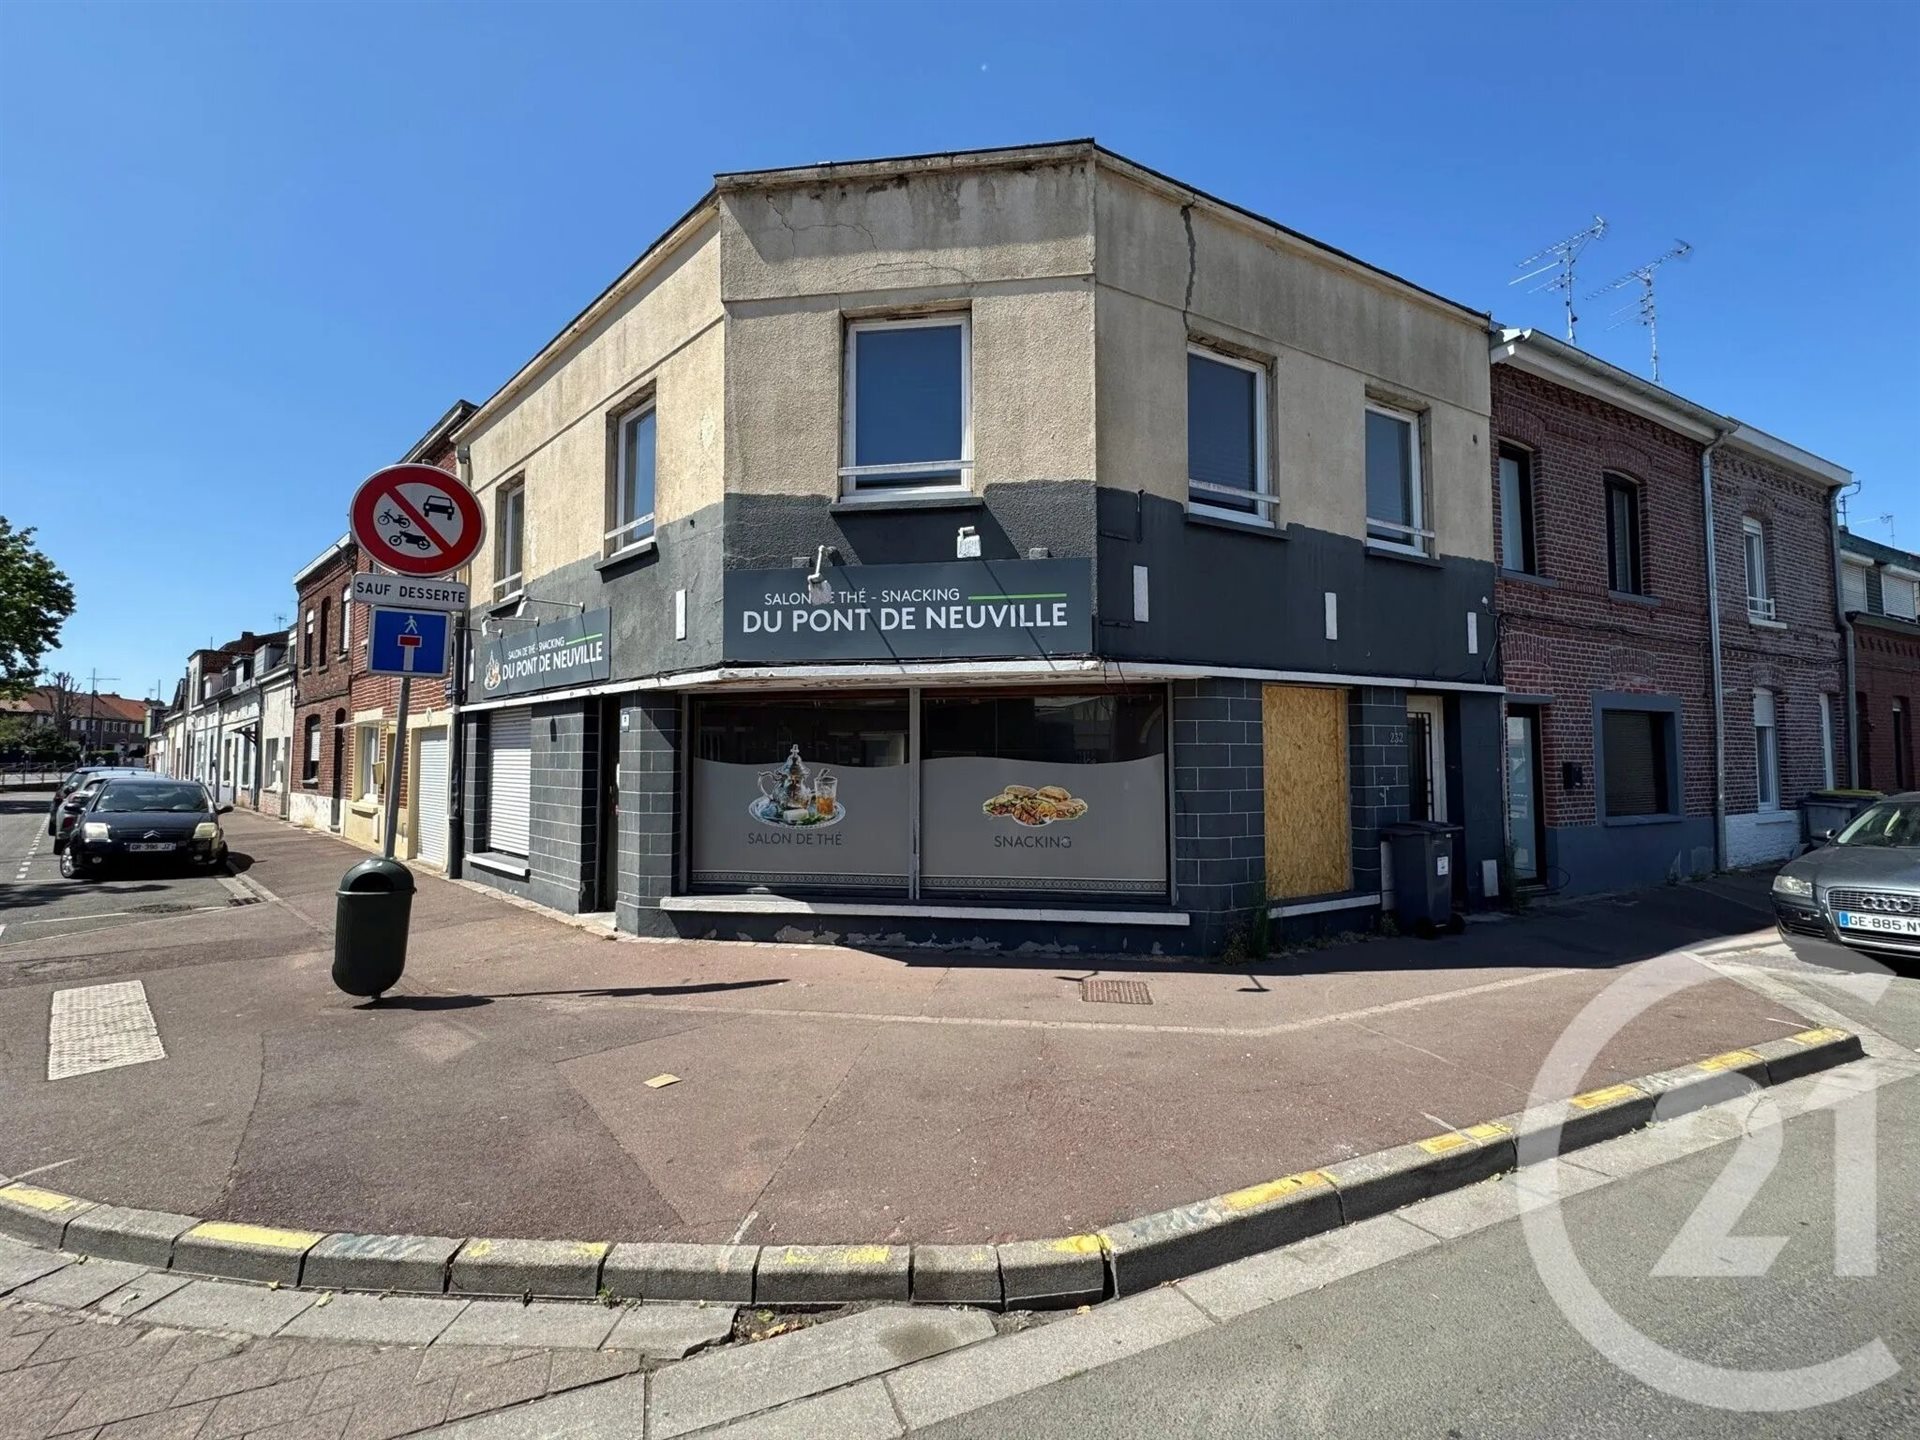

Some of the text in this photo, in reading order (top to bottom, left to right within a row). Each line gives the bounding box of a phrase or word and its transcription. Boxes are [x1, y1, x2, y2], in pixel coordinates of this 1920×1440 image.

[356, 581, 466, 603] SAUF DESSERTE
[764, 592, 811, 605] SALON
[838, 588, 867, 604] THÉ
[881, 588, 960, 603] SNACKING
[743, 602, 1068, 633] DU PONT DE NEUVILLE
[502, 641, 603, 680] DU PONT DE NEUVILLE
[748, 831, 843, 845] SALON DE THÉ
[994, 835, 1072, 848] SNACKING
